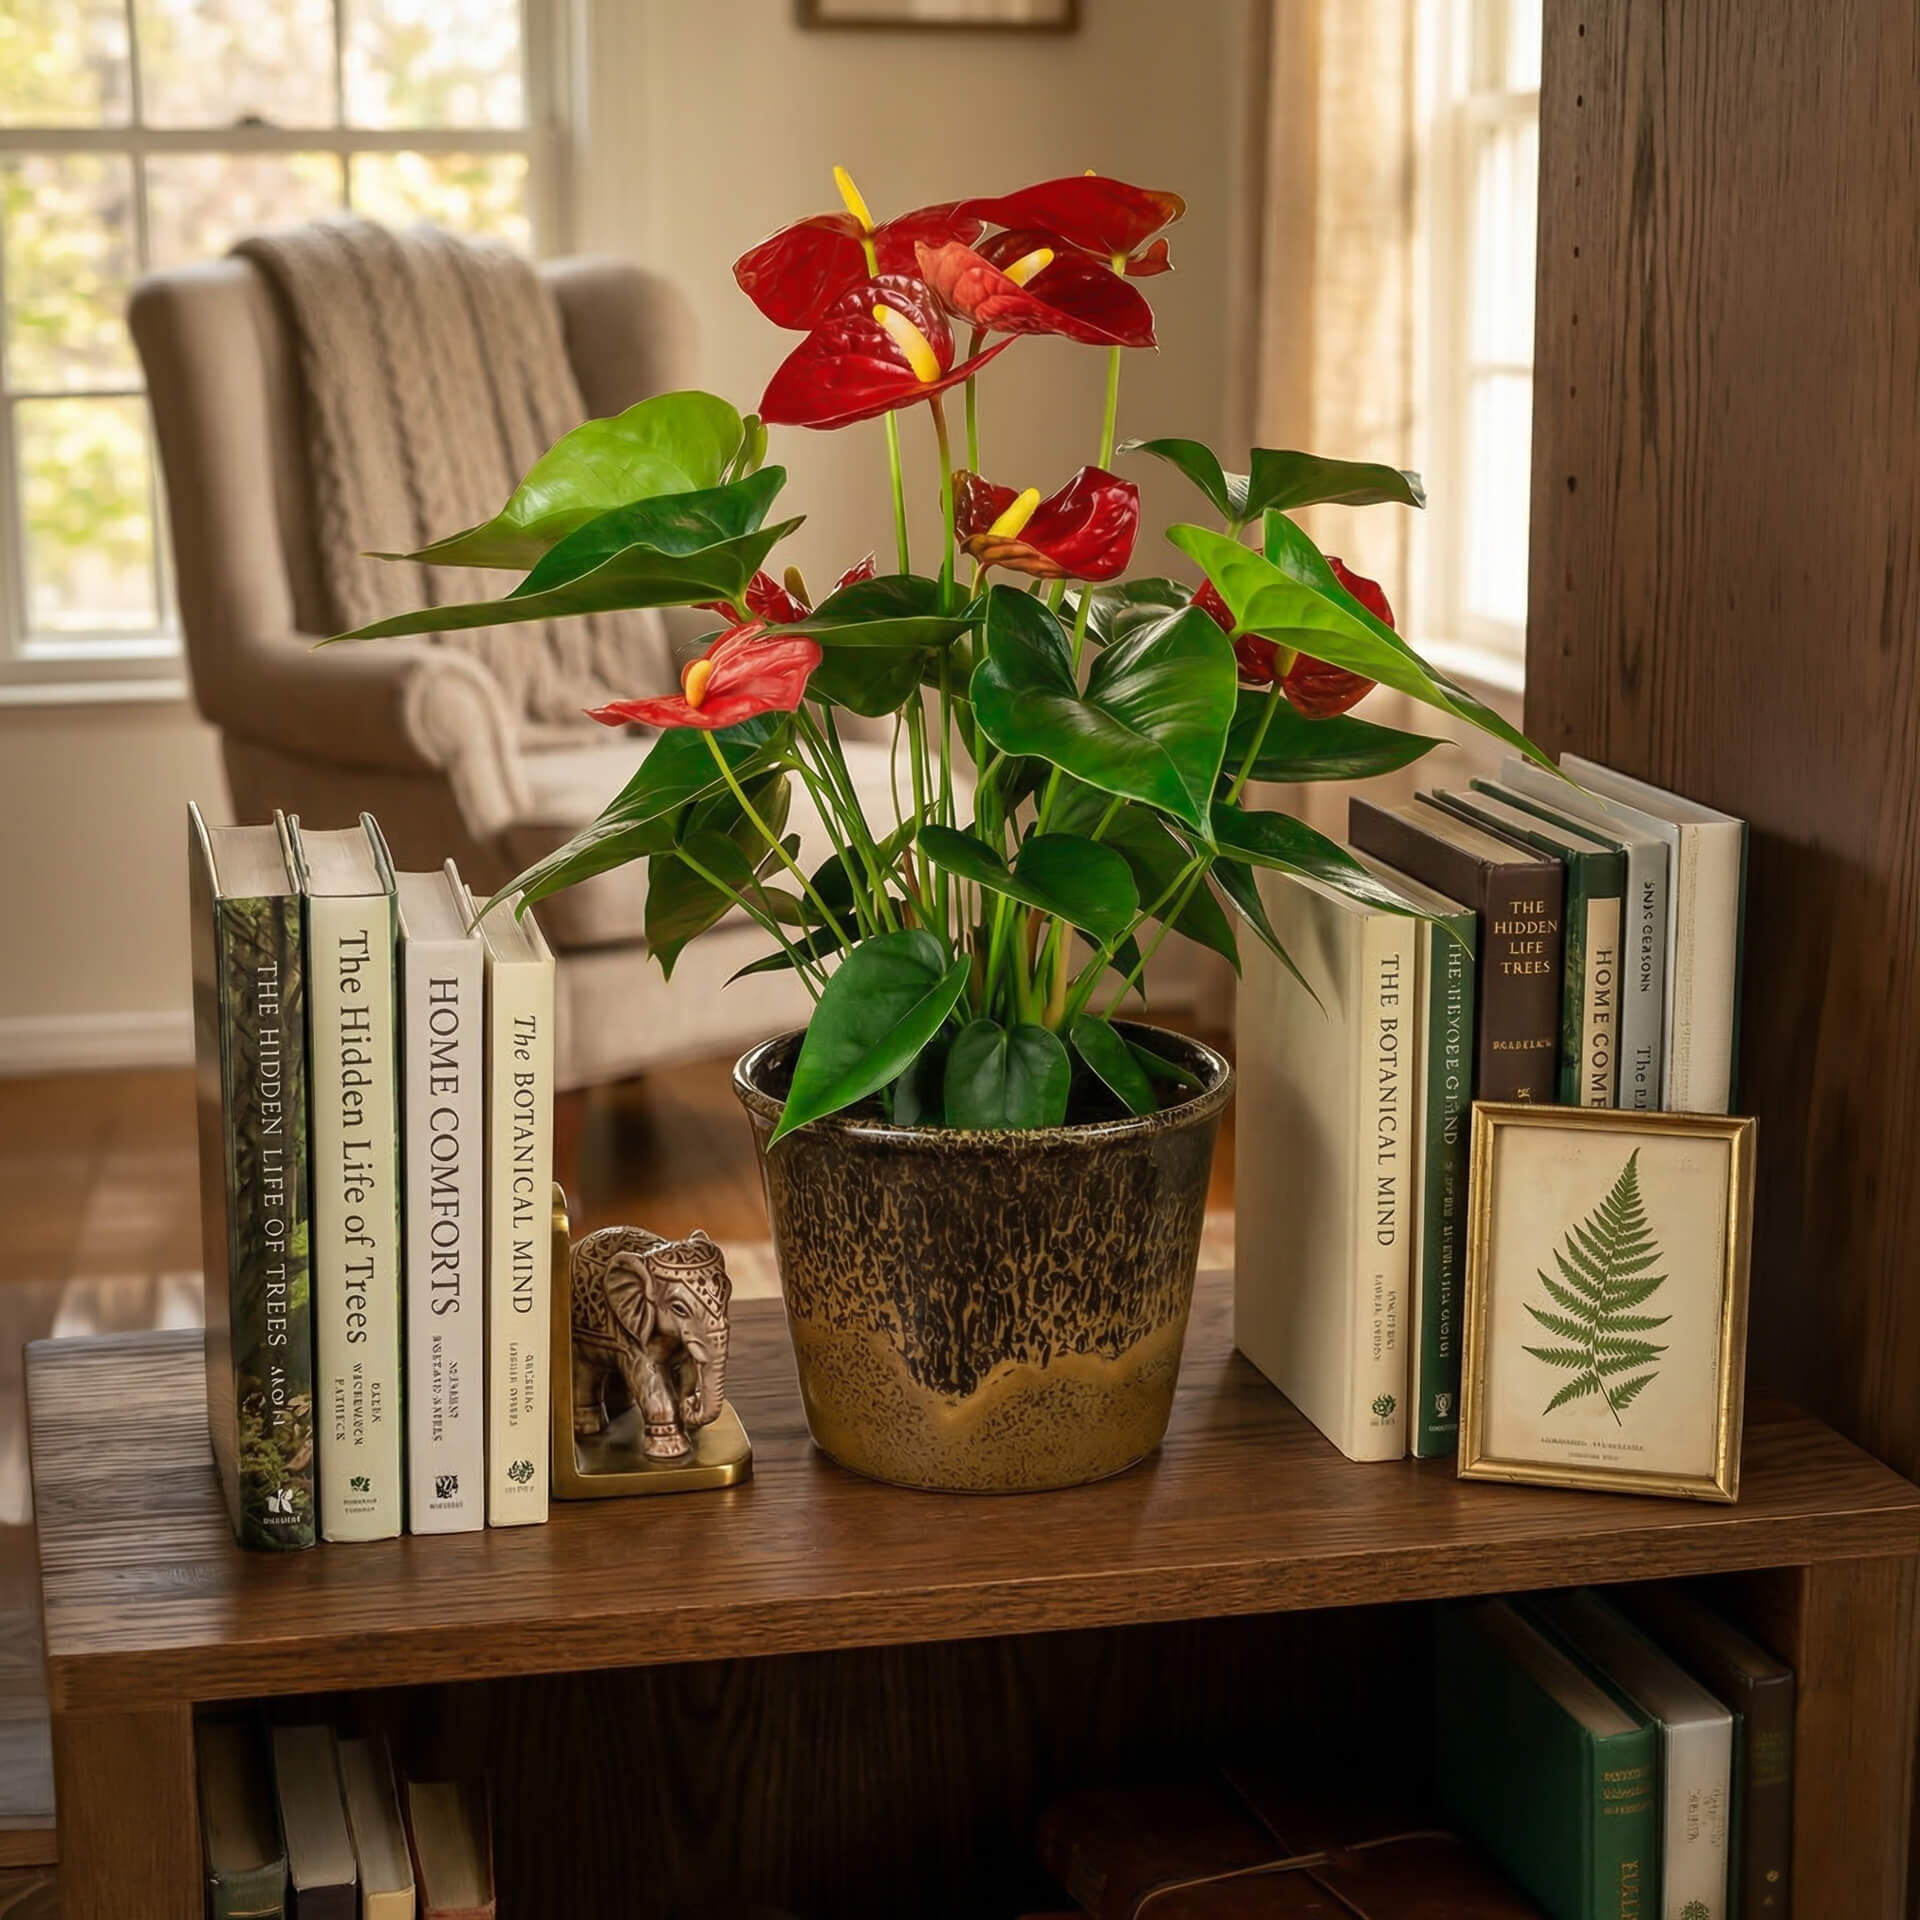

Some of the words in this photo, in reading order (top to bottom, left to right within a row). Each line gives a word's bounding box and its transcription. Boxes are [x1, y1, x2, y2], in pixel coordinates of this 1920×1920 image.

[1494, 919, 1558, 935] HIDDEN
[1509, 900, 1545, 915] THE
[338, 929, 371, 994] The
[1500, 960, 1551, 975] TREES
[1509, 941, 1544, 955] LIFE
[257, 960, 279, 1017] THE
[1380, 954, 1400, 1008] THE
[1592, 948, 1613, 1025] HOME
[340, 1005, 373, 1129] Hidden
[429, 976, 459, 1097] HOME
[513, 1015, 537, 1061] The
[258, 1028, 283, 1136] HIDDEN
[1377, 1016, 1399, 1166] BOTANICAL
[262, 1148, 285, 1208] LIFE
[342, 1140, 375, 1204] Life
[512, 1072, 536, 1229] BOTANICAL
[264, 1218, 286, 1253] OF
[344, 1214, 376, 1248] of
[429, 1107, 461, 1316] COMFORTS
[1376, 1177, 1396, 1247] MIND
[265, 1263, 288, 1347] TREES
[345, 1256, 375, 1344] Trees
[512, 1239, 534, 1314] MIND
